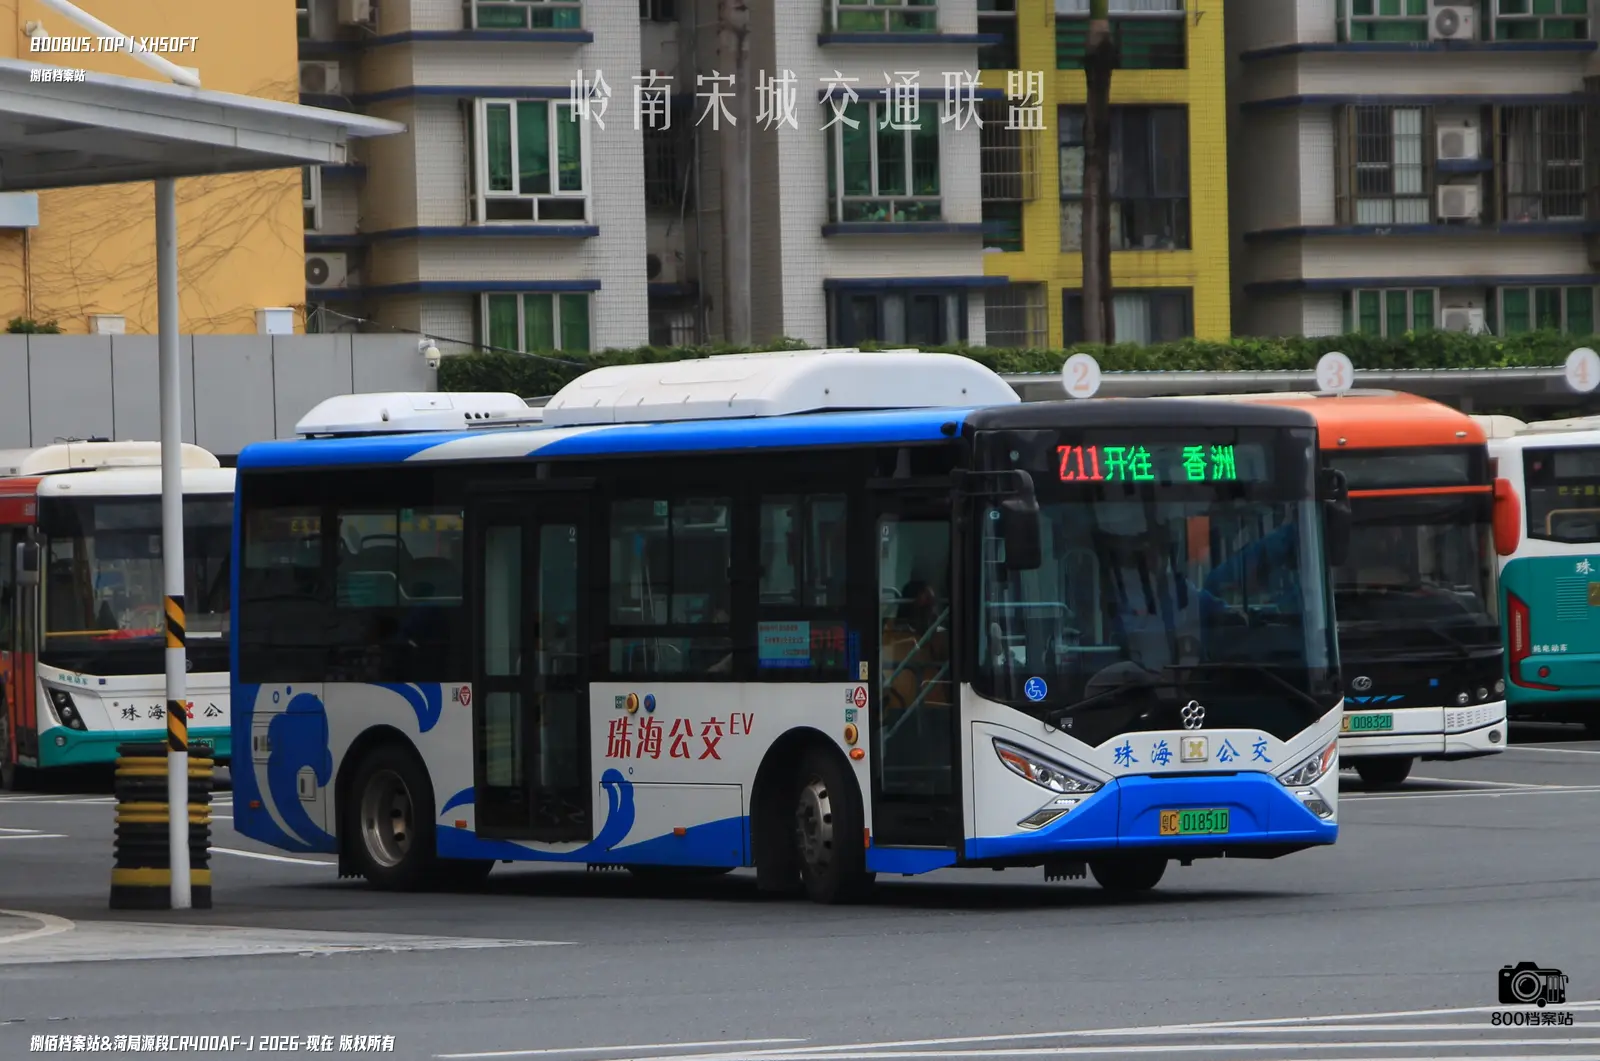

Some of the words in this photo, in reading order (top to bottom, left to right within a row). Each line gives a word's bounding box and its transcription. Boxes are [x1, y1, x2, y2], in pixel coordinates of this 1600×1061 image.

[1072, 361, 1091, 391] 2
[1326, 360, 1345, 388] 3
[1573, 356, 1590, 384] 4
